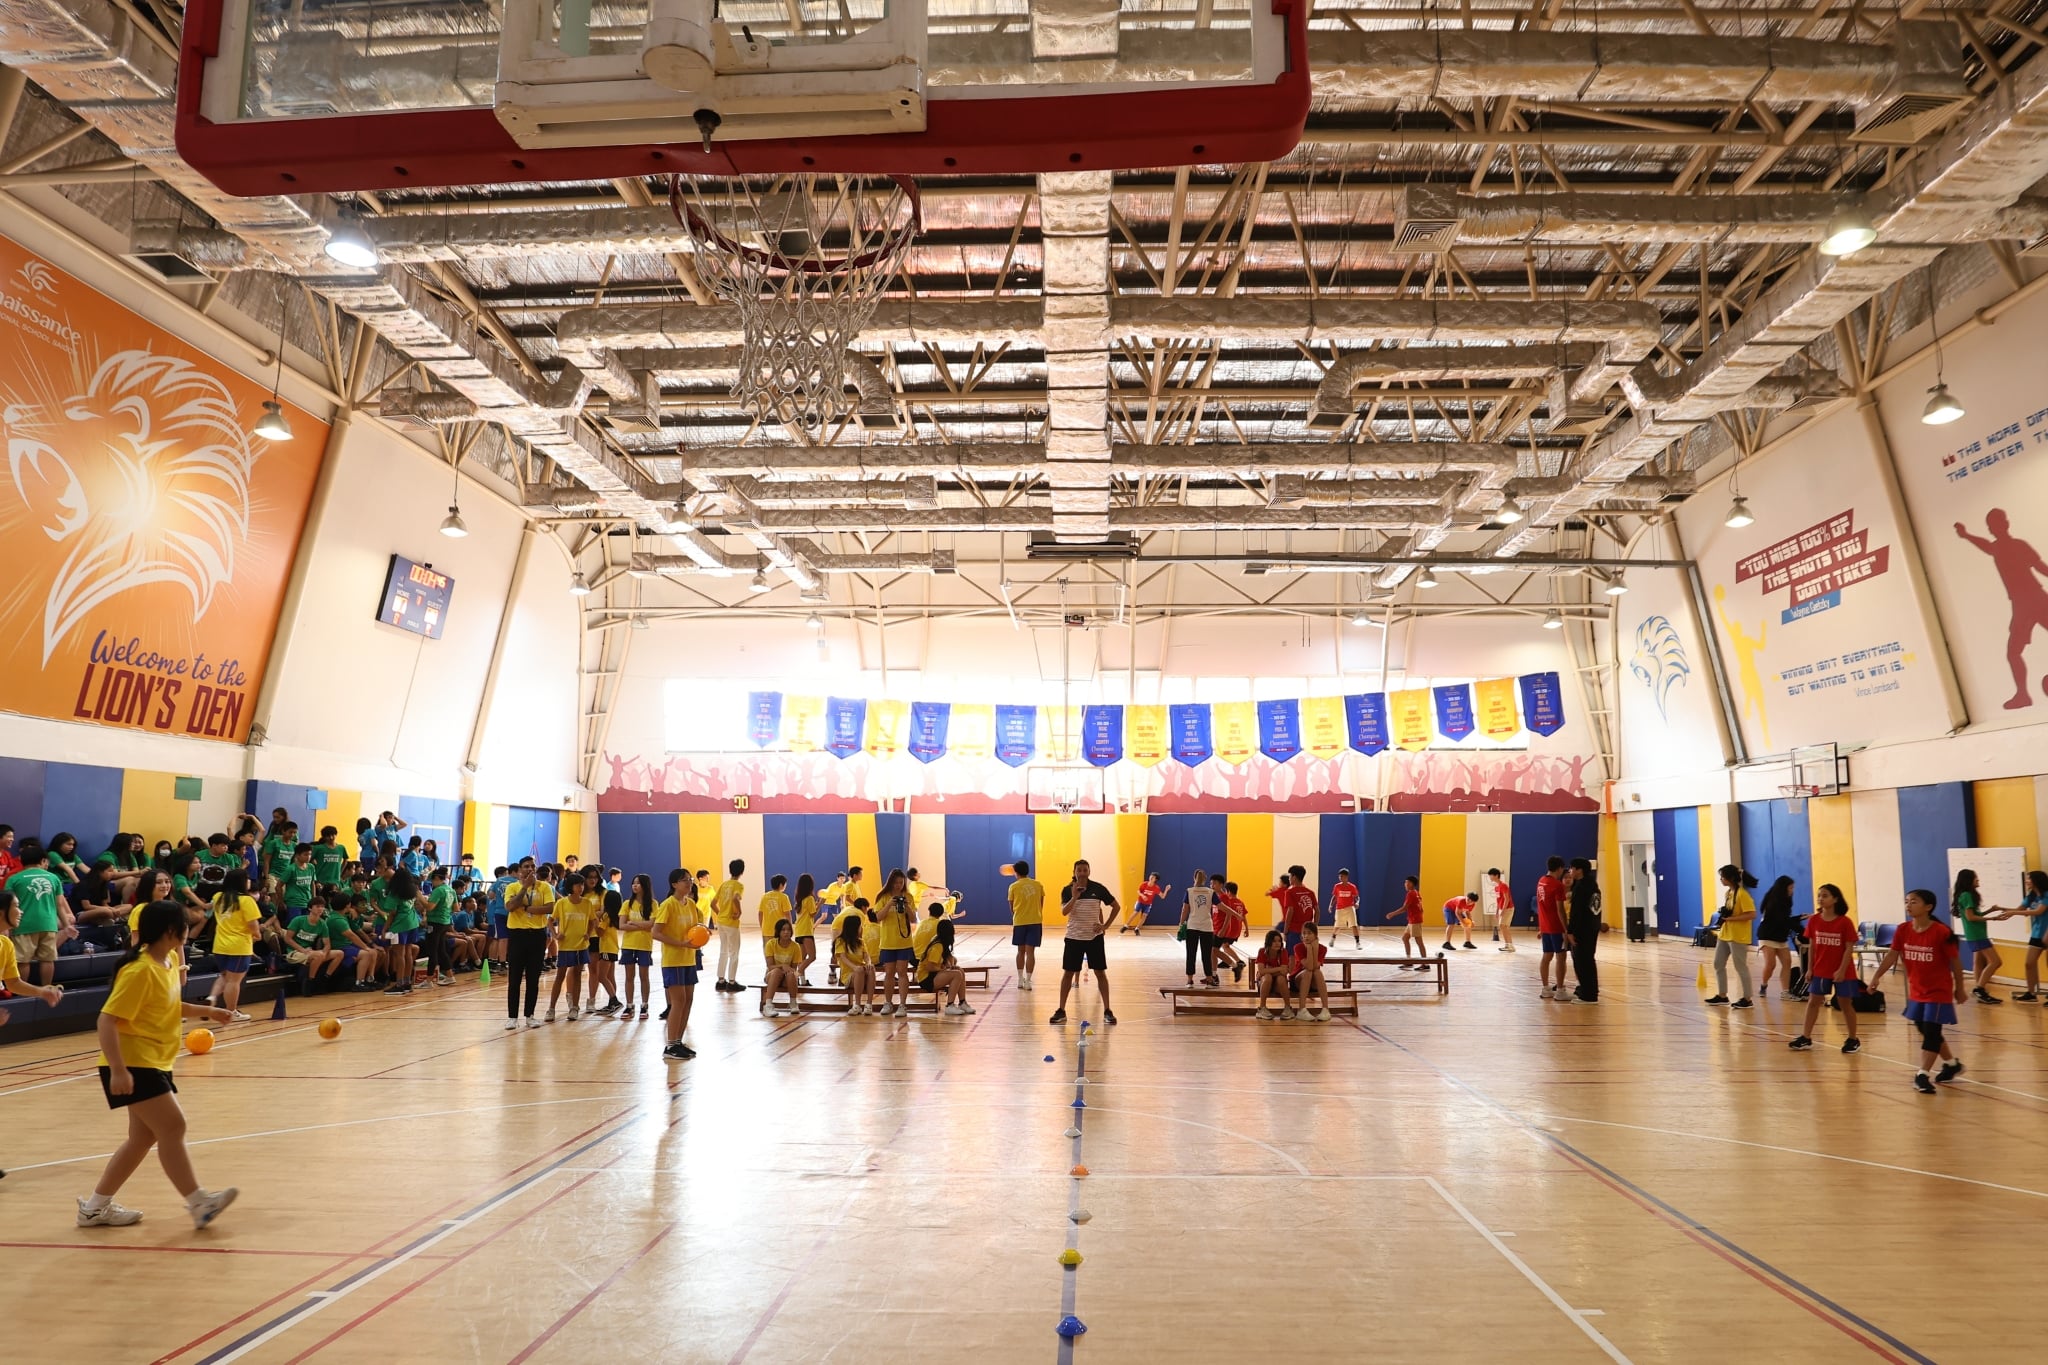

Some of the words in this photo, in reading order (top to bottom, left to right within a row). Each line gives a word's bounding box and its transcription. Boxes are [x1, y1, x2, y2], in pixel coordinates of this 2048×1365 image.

[21, 323, 51, 343] SCHOOL
[1986, 422, 2021, 446] MORE
[2026, 407, 2048, 428] DIF
[1946, 466, 1968, 483] THE
[1971, 440, 2024, 472] GREATER
[1764, 567, 1790, 590] THE
[1789, 549, 1833, 580] SHOTS
[1832, 536, 1862, 562] YOU
[1769, 538, 1800, 566] MISS
[1799, 524, 1831, 551] 100%
[1830, 515, 1850, 539] OF
[90, 629, 188, 675] Welcome
[191, 653, 214, 680] to
[216, 659, 246, 686] the
[1788, 683, 1805, 696] BUT
[1808, 674, 1847, 691] WANTING
[1850, 669, 1865, 681] TO
[1868, 664, 1888, 677] WIN
[74, 663, 182, 729] LION'S
[186, 684, 245, 738] DEN
